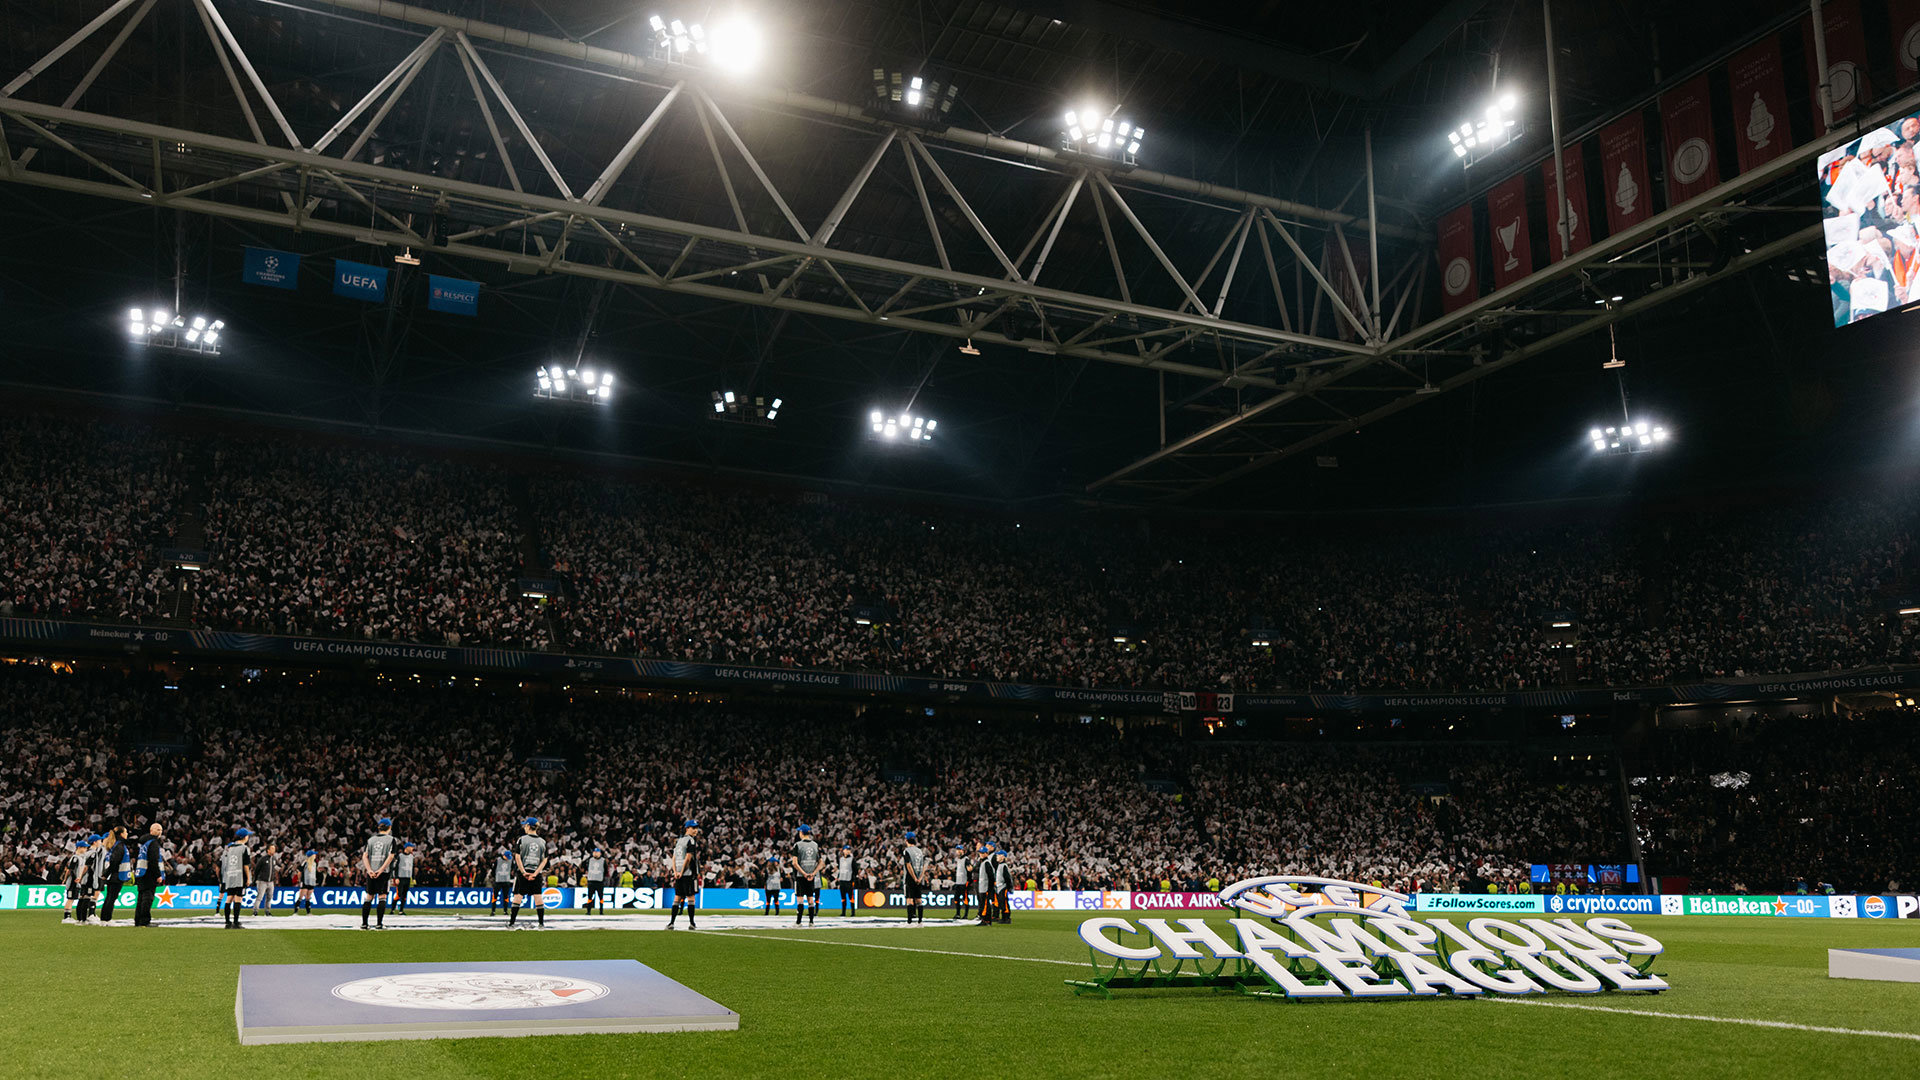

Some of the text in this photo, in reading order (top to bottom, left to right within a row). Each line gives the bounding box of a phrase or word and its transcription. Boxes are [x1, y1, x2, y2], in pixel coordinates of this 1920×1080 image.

[341, 273, 378, 290] UEFA
[444, 291, 475, 302] RESPECT
[90, 629, 131, 639] Heineken
[293, 641, 448, 660] UEFA CHAMPIONS LEAGUE
[715, 668, 840, 685] UEFA CHAMPIONS LEAGUE
[1758, 674, 1905, 693] UEFA CHAMPIONS LEAGUE
[943, 683, 968, 692] PEPSI
[1055, 690, 1076, 699] UEFA
[1077, 692, 1129, 703] CHAMPIONS
[1384, 696, 1507, 706] UEFA CHAMPIONS LEAGUE
[270, 890, 492, 905] UEA CHAINS LEAGU
[574, 887, 664, 909] PEPSI
[889, 892, 992, 906] msterar
[1075, 890, 1123, 909] FedEx
[1134, 893, 1226, 910] QATAR AIRW
[1433, 897, 1536, 909] FollowScores.com
[1566, 895, 1653, 913] crypto.com
[1689, 897, 1772, 914] Heineken
[1895, 896, 1920, 918] P
[1077, 917, 1664, 960] CHAMPIONS
[1243, 949, 1671, 998] LEAGUE
